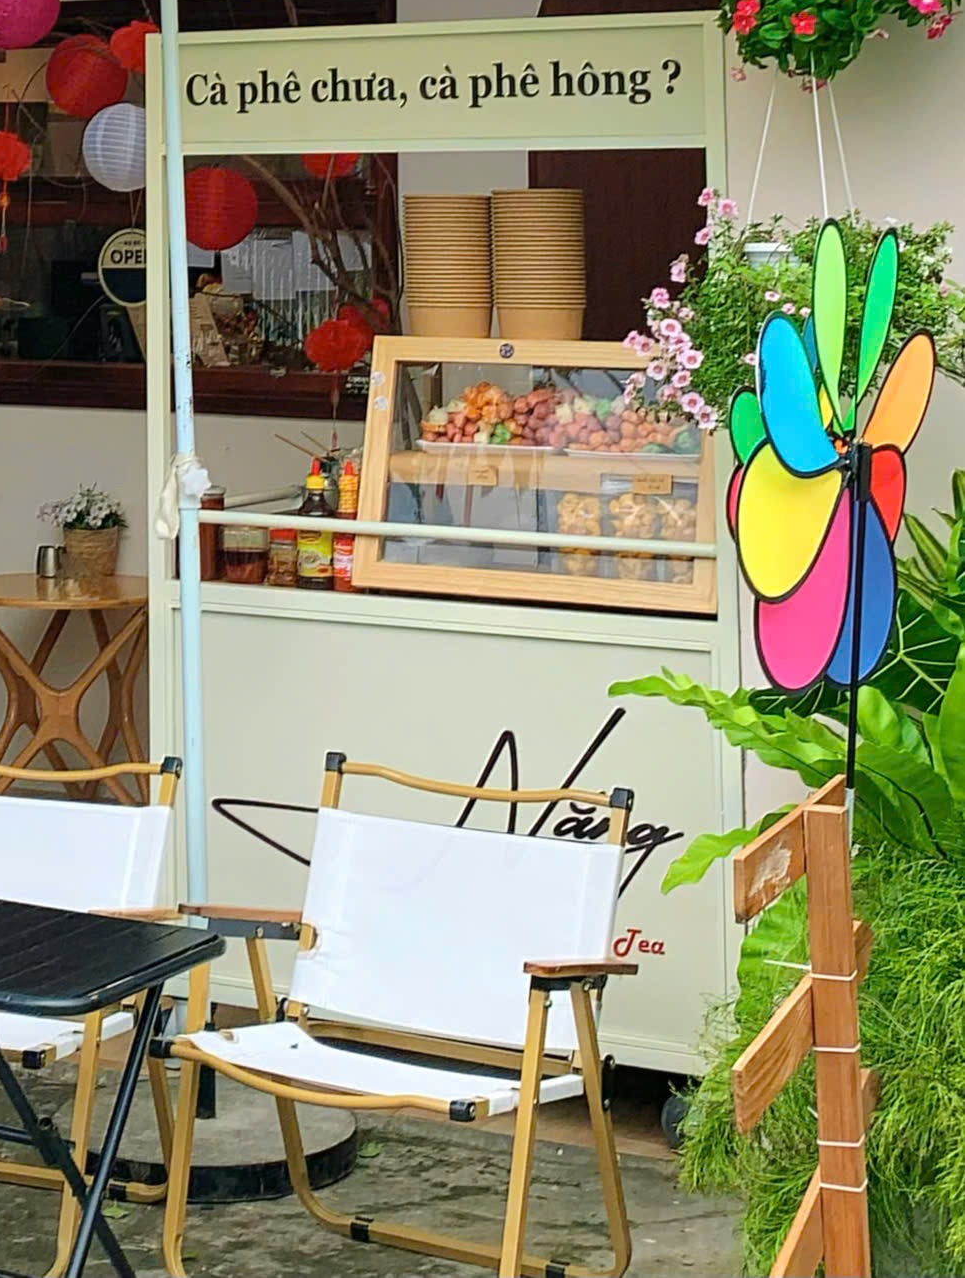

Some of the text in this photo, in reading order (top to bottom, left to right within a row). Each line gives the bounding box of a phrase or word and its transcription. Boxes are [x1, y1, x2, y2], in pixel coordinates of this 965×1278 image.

[185, 72, 228, 106] Cà
[236, 69, 301, 114] phê
[311, 67, 408, 108] chưa,
[419, 64, 459, 100] cà
[468, 62, 540, 108] phê
[549, 60, 652, 105] hông
[110, 249, 147, 265] OPE
[613, 928, 666, 958] Tea
